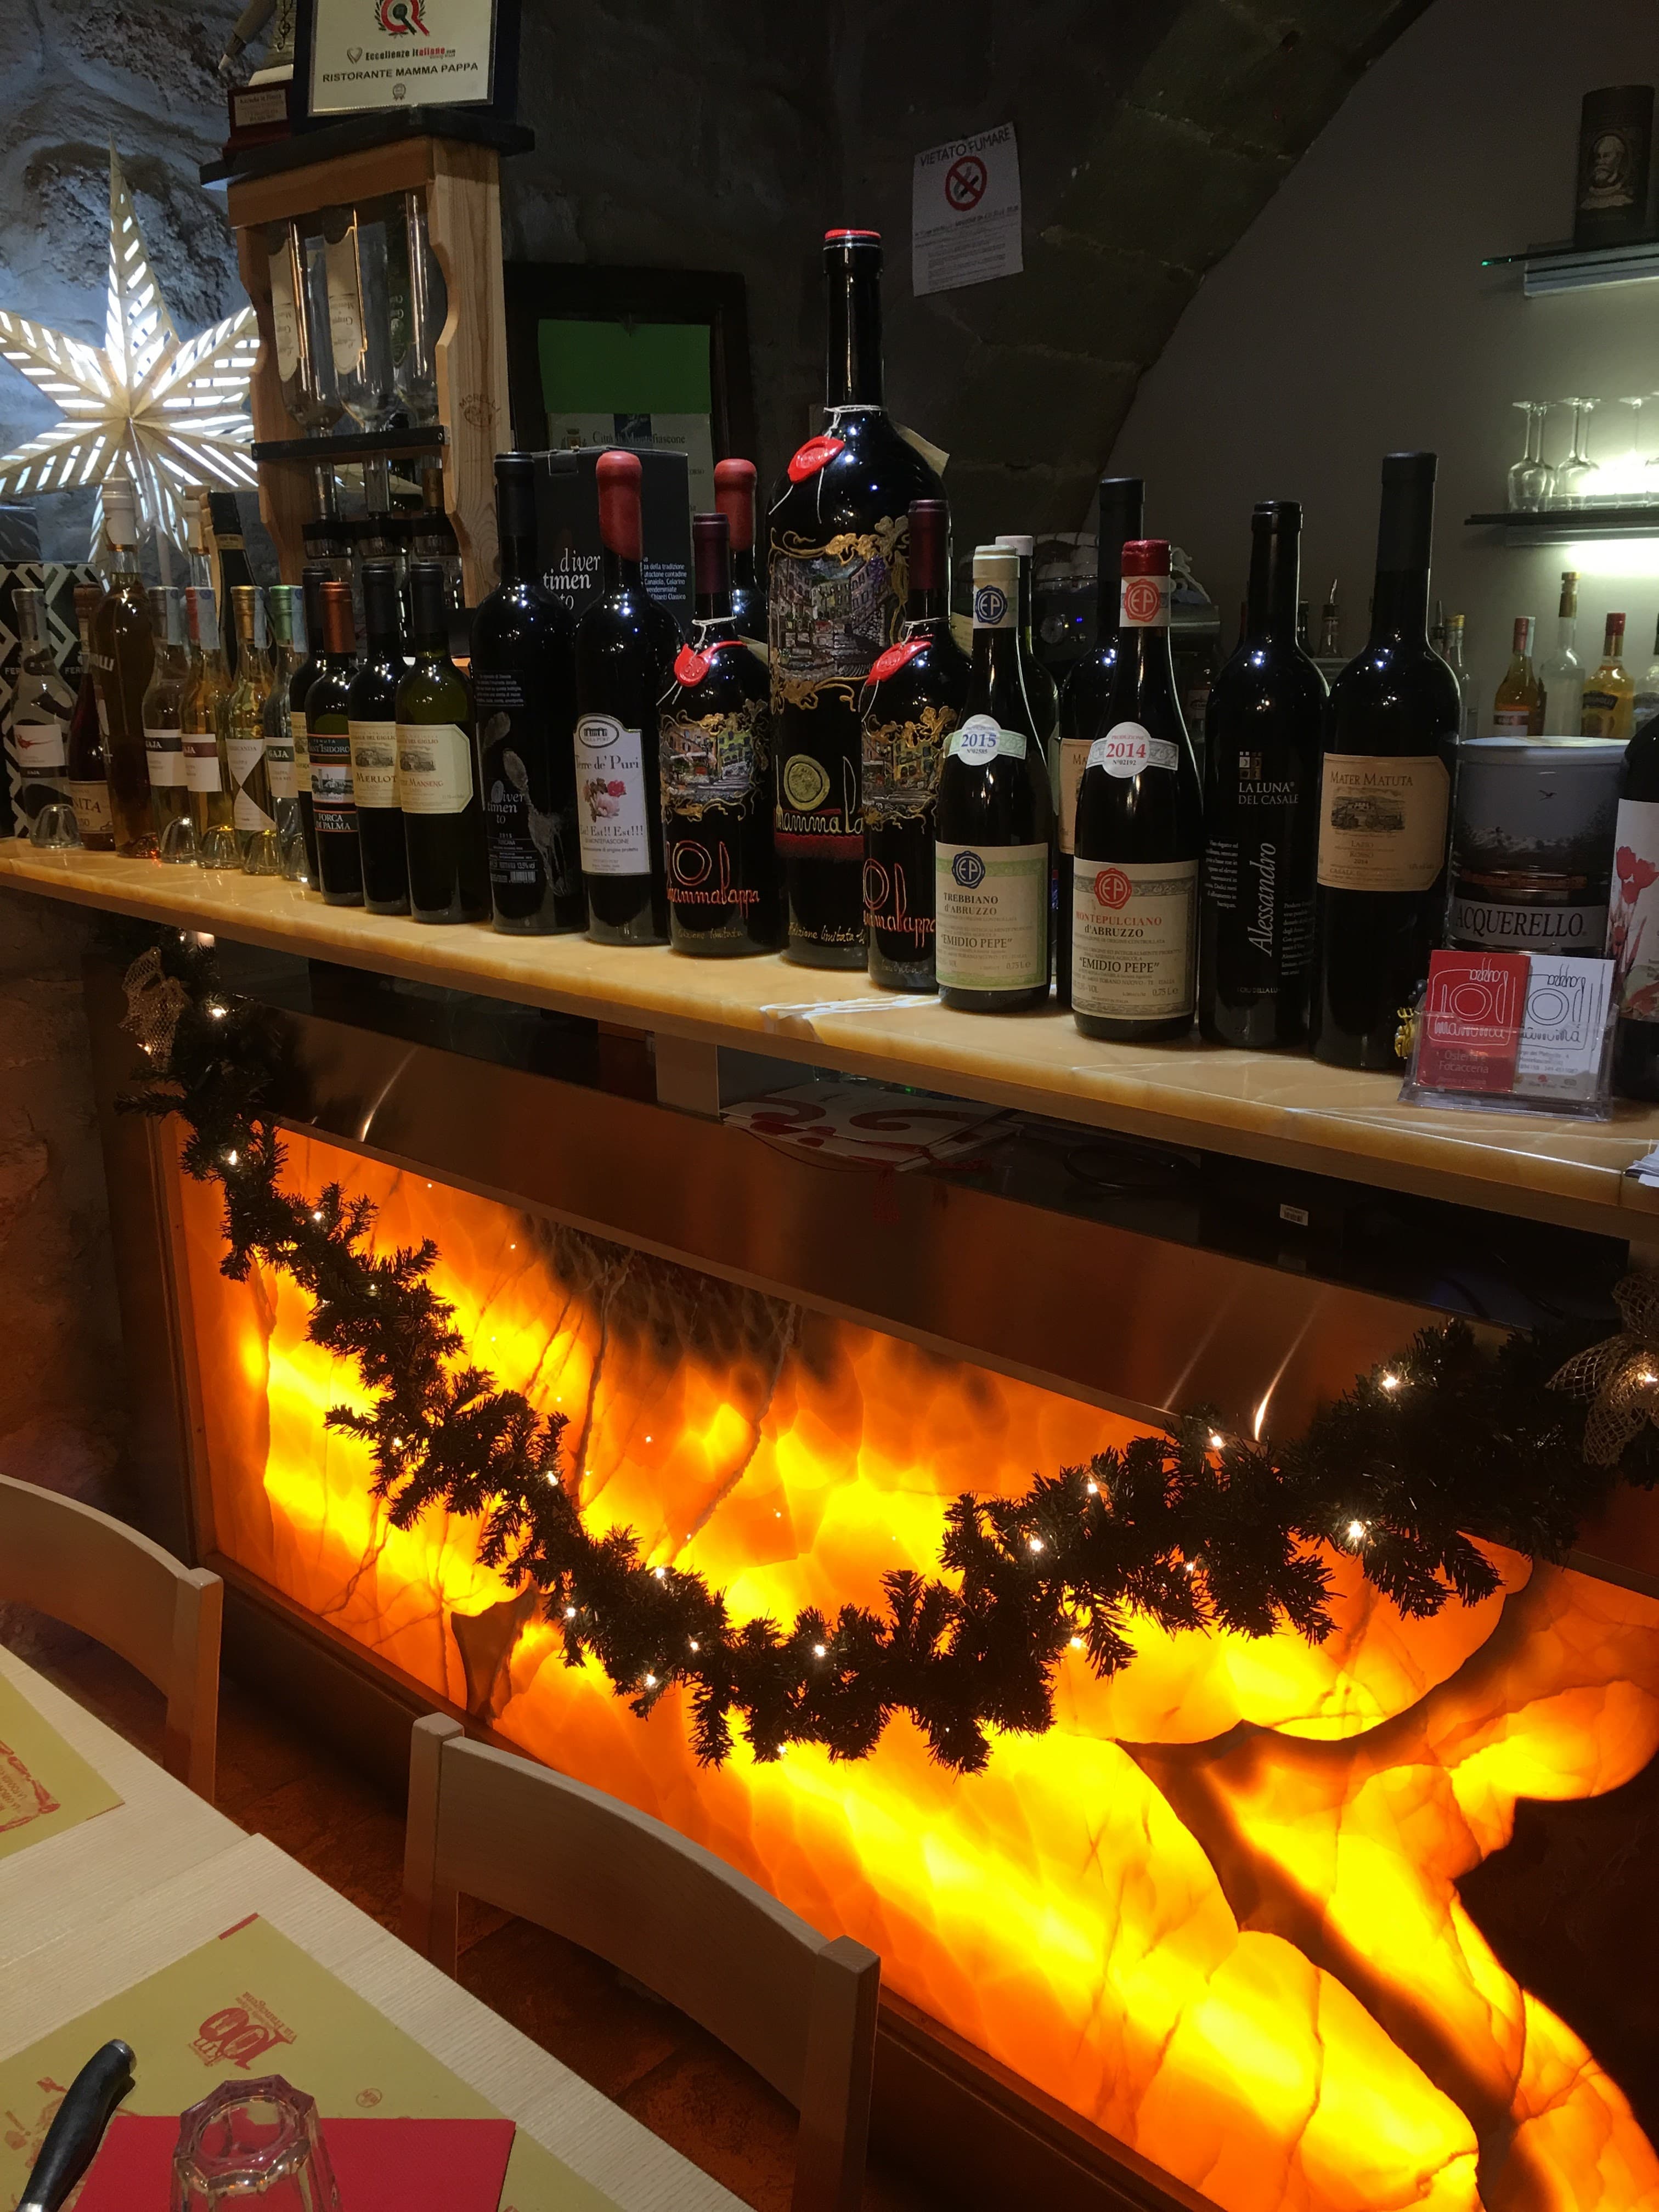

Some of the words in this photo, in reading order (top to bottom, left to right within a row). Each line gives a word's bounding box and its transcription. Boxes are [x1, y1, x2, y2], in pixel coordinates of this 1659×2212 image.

[323, 70, 392, 82] RISTORANTE
[396, 65, 438, 76] MAMMA
[441, 63, 478, 73] PAPPA
[920, 144, 967, 166] VIETATO
[968, 127, 1010, 153] FUMARE
[543, 568, 591, 590] timen
[961, 732, 996, 748] 2015
[268, 749, 290, 759] GAJA
[1105, 743, 1146, 759] 2014
[610, 755, 639, 769] Puri
[356, 772, 397, 783] MERLOT
[410, 778, 444, 787] MANSENG
[1330, 770, 1361, 785] MATER
[1363, 772, 1414, 787] MATUTA
[1238, 782, 1254, 793] LA
[1238, 794, 1259, 805] DEL
[1261, 794, 1299, 805] CASALE
[323, 822, 351, 830] PALMA
[591, 826, 611, 836] Est!!
[614, 825, 644, 836] Est!!!
[943, 892, 999, 905] TREBBIANO
[1246, 842, 1277, 957] Alessandro
[944, 904, 997, 916] d'ABRUZZO
[1076, 911, 1163, 926] MONTEPULCIANO
[1455, 906, 1584, 938] ACQUERELLO
[1085, 924, 1144, 938] d'ABRUZZO
